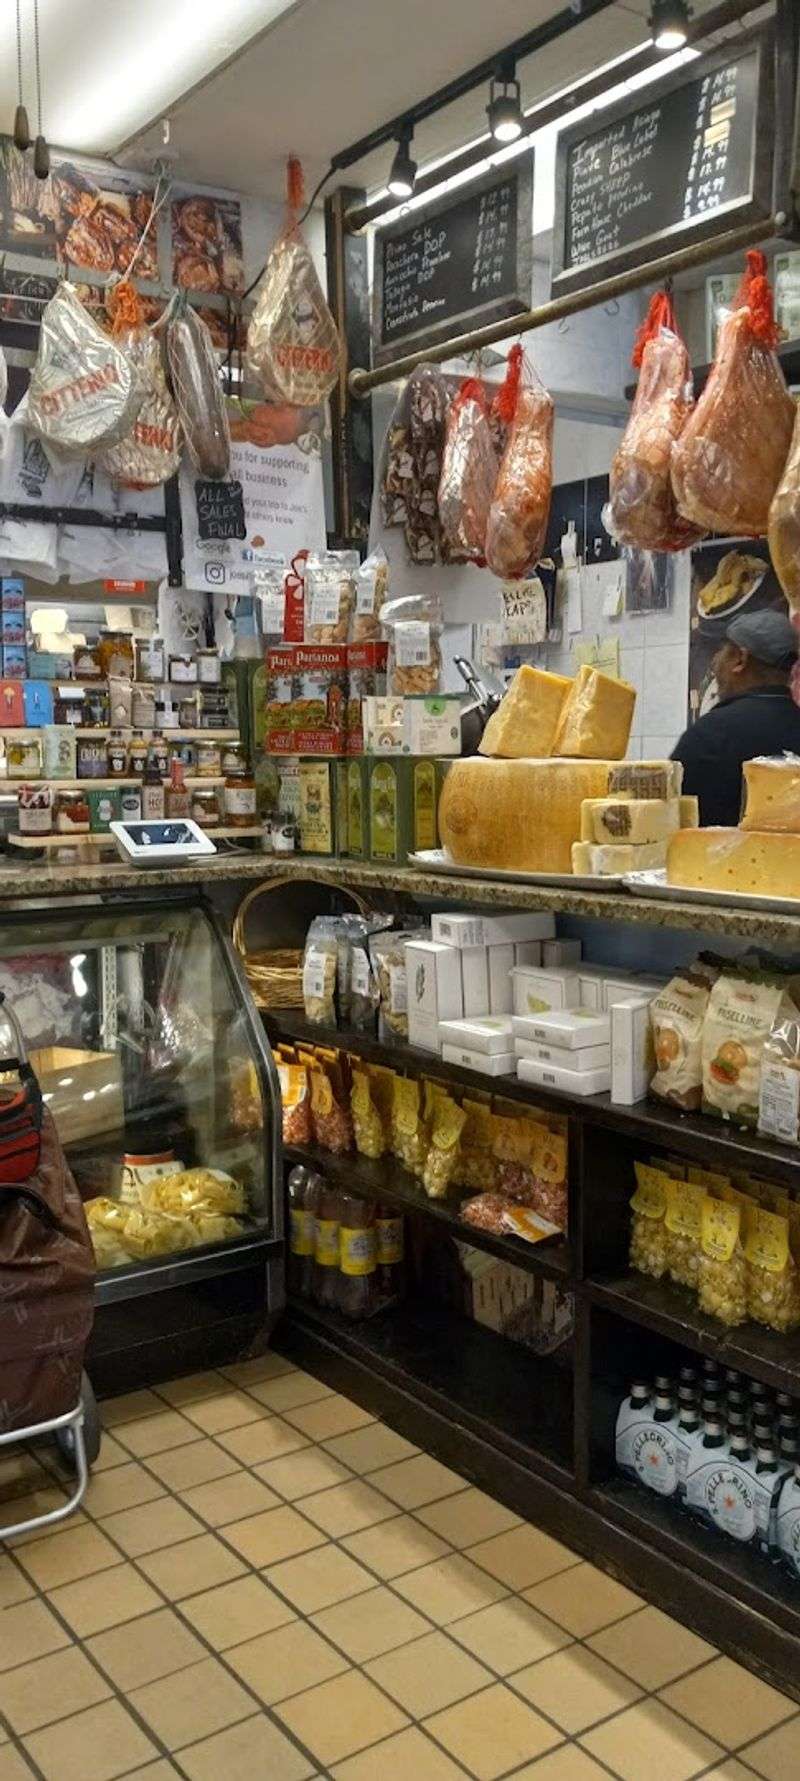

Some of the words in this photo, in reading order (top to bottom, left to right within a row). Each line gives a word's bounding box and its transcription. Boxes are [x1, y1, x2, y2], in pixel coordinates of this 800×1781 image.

[424, 231, 447, 254] DOP
[261, 456, 310, 475] supporting
[245, 470, 288, 488] business
[198, 487, 225, 503] ALL
[200, 503, 238, 521] SALES
[208, 520, 241, 538] FINAL
